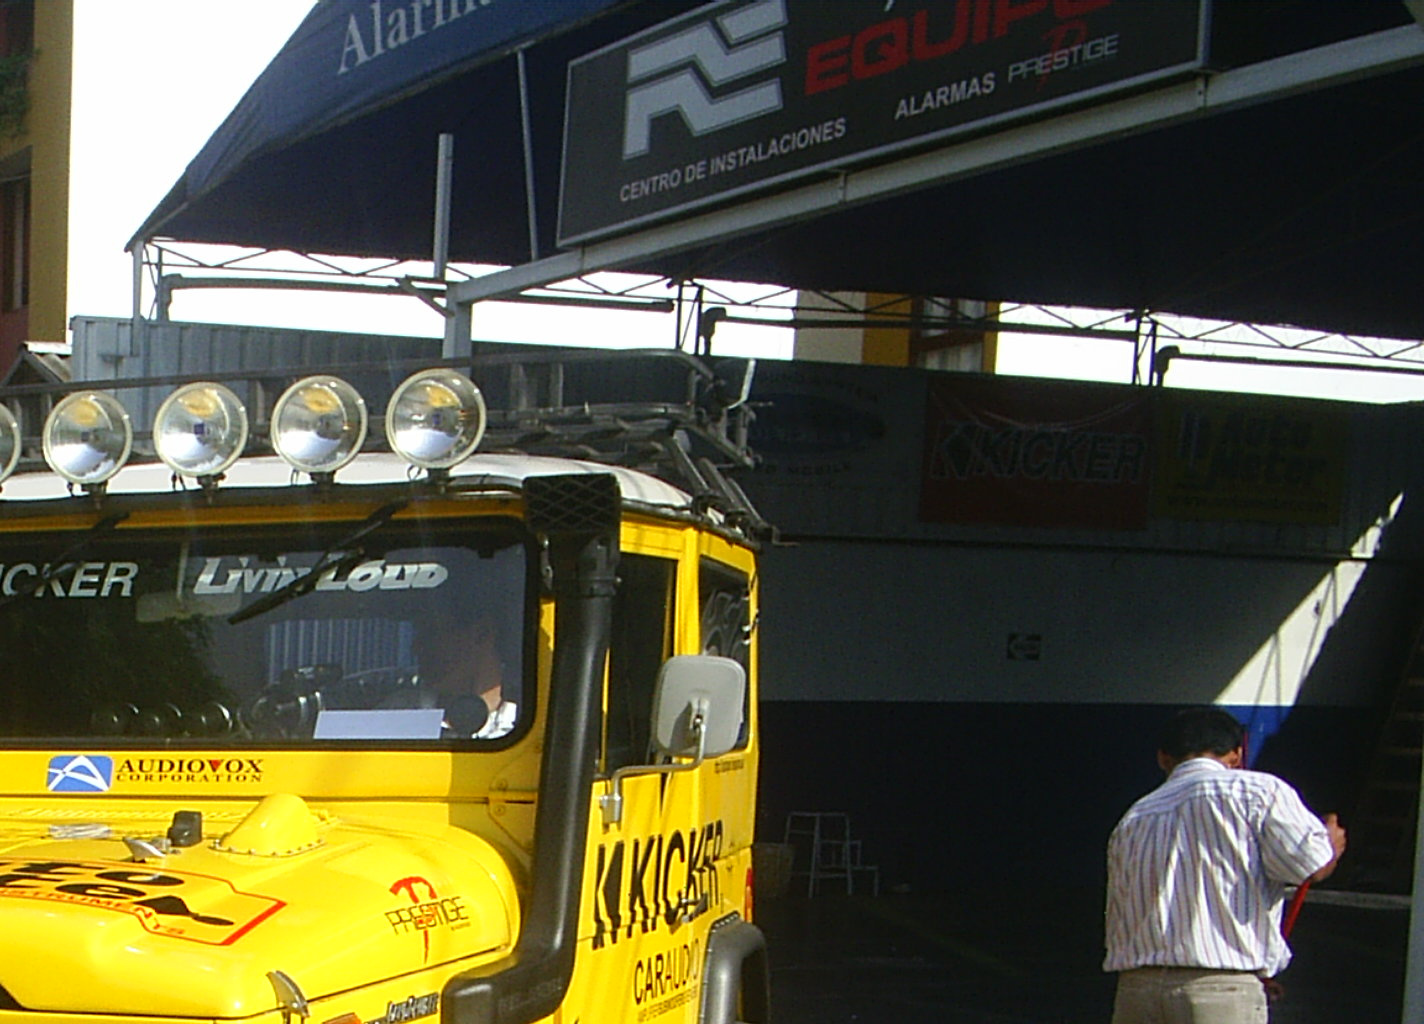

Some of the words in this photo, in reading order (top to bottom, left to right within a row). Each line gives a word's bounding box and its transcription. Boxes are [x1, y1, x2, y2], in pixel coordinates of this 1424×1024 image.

[895, 72, 996, 120] ALARMAS
[1007, 34, 1119, 84] PRESTIGE
[620, 168, 681, 202] CENTRO
[684, 160, 708, 184] DE
[710, 117, 847, 176] INSTALACIONES
[976, 425, 1147, 485] KICKER
[116, 774, 262, 783] CORPORATION
[118, 758, 264, 774] AUDIOVOX
[627, 820, 723, 938] KICKER
[384, 896, 469, 935] PRESTIGE
